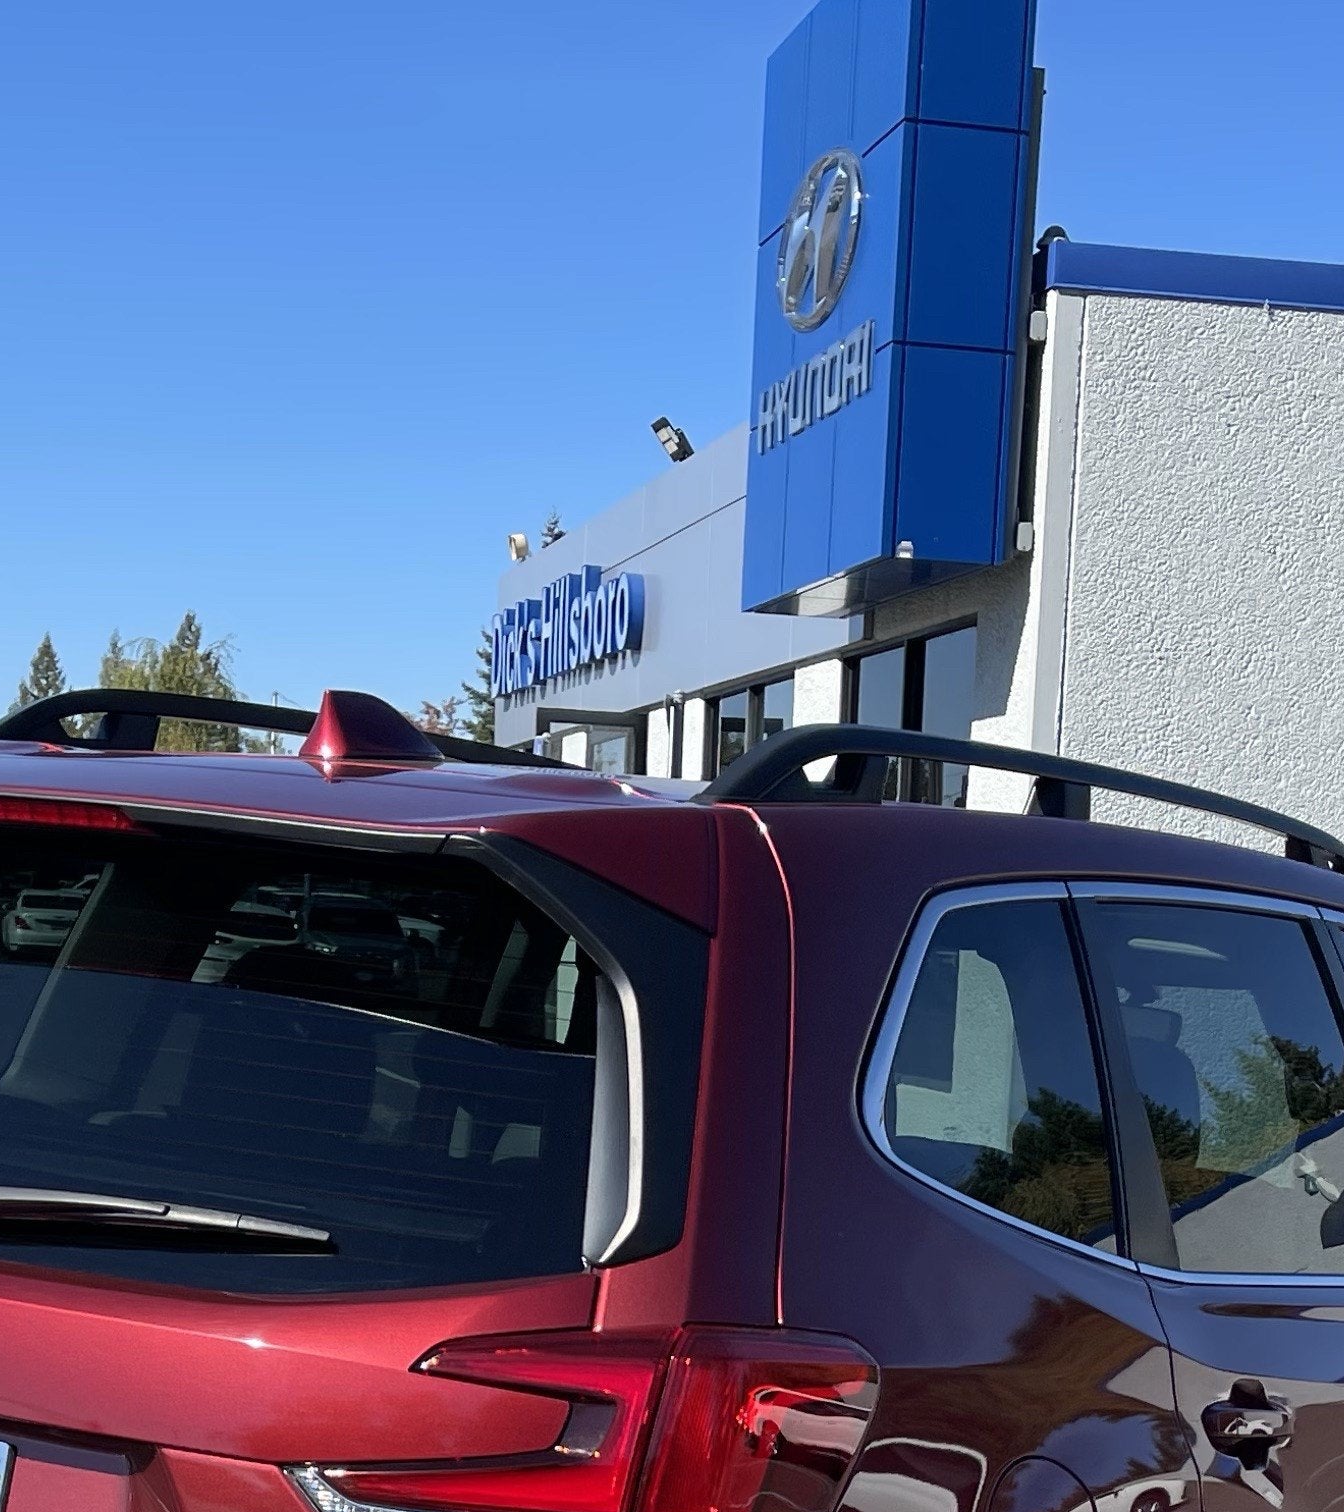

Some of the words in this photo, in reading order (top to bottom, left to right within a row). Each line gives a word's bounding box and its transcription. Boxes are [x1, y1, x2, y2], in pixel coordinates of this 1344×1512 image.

[757, 319, 875, 456] HYUNDAI
[491, 599, 538, 699] Dick's
[540, 565, 637, 680] Hillsboro
